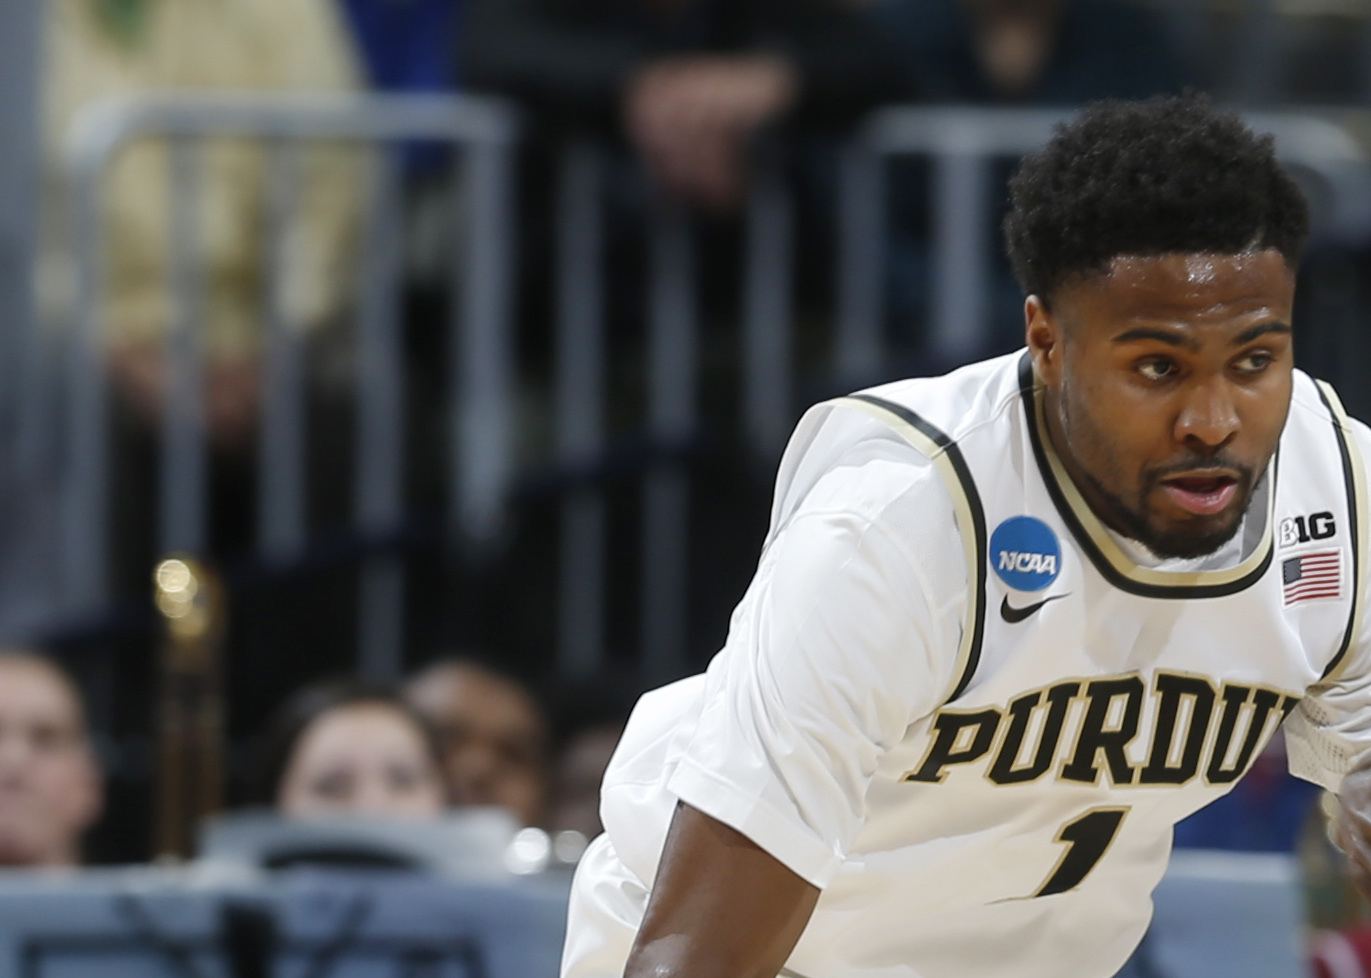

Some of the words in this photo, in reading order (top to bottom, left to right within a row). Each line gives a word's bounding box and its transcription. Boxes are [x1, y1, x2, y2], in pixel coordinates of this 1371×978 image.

[998, 550, 1056, 576] NCAA
[899, 668, 1302, 786] PURDU
[1035, 805, 1132, 899] 1
